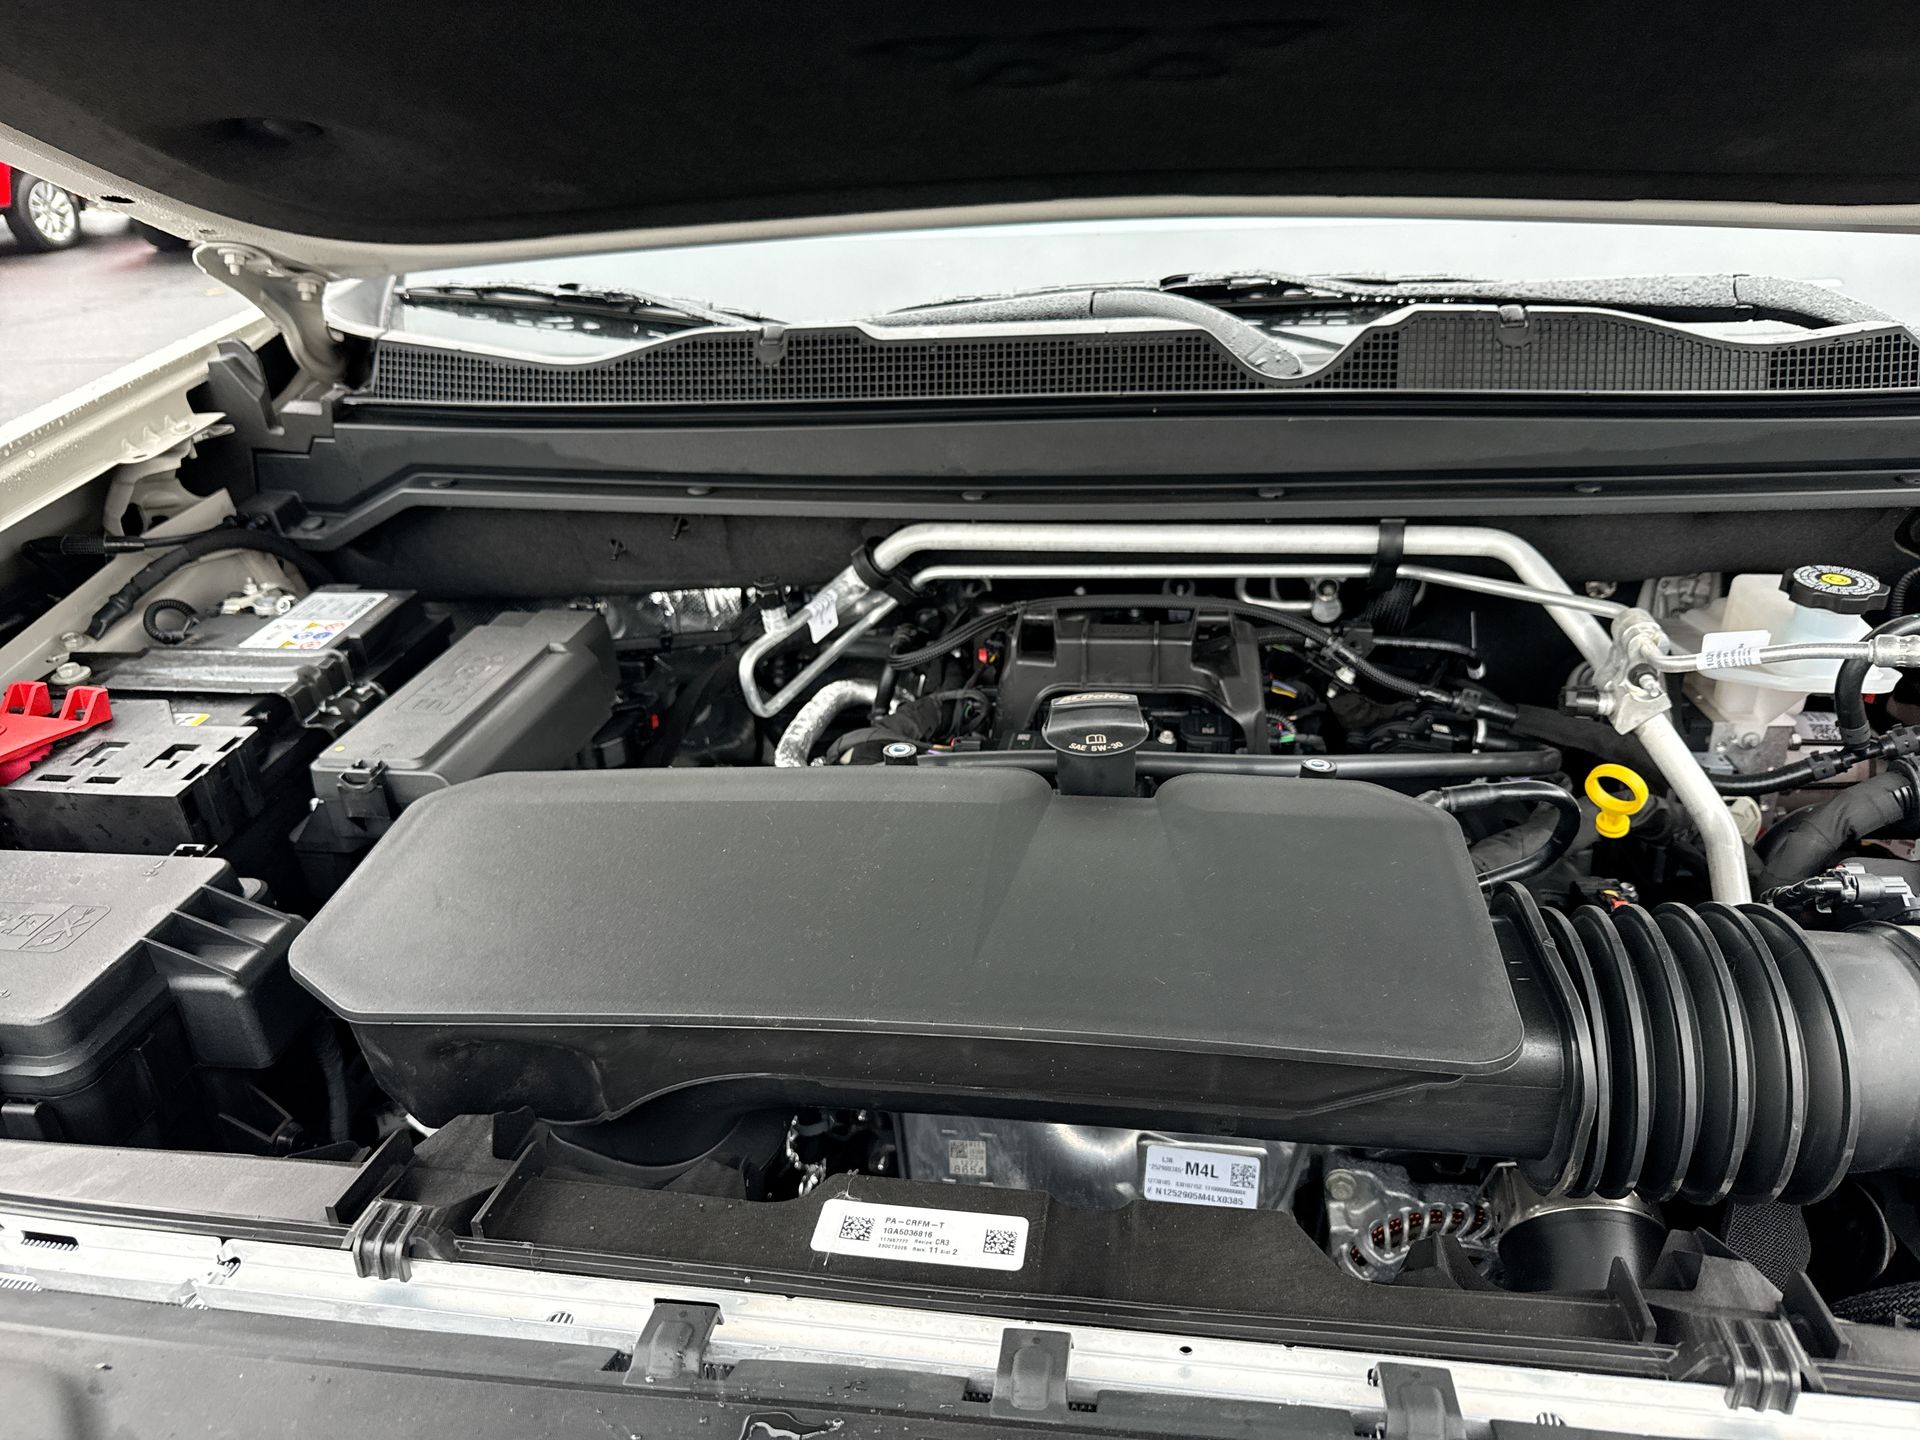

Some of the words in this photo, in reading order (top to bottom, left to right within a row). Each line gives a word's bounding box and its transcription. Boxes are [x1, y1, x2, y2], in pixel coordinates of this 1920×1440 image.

[1068, 742, 1087, 751] SAE
[1091, 741, 1124, 752] 5W-30
[1185, 1161, 1219, 1179] M4L
[935, 1238, 950, 1246] CR3
[929, 1246, 938, 1254] 11
